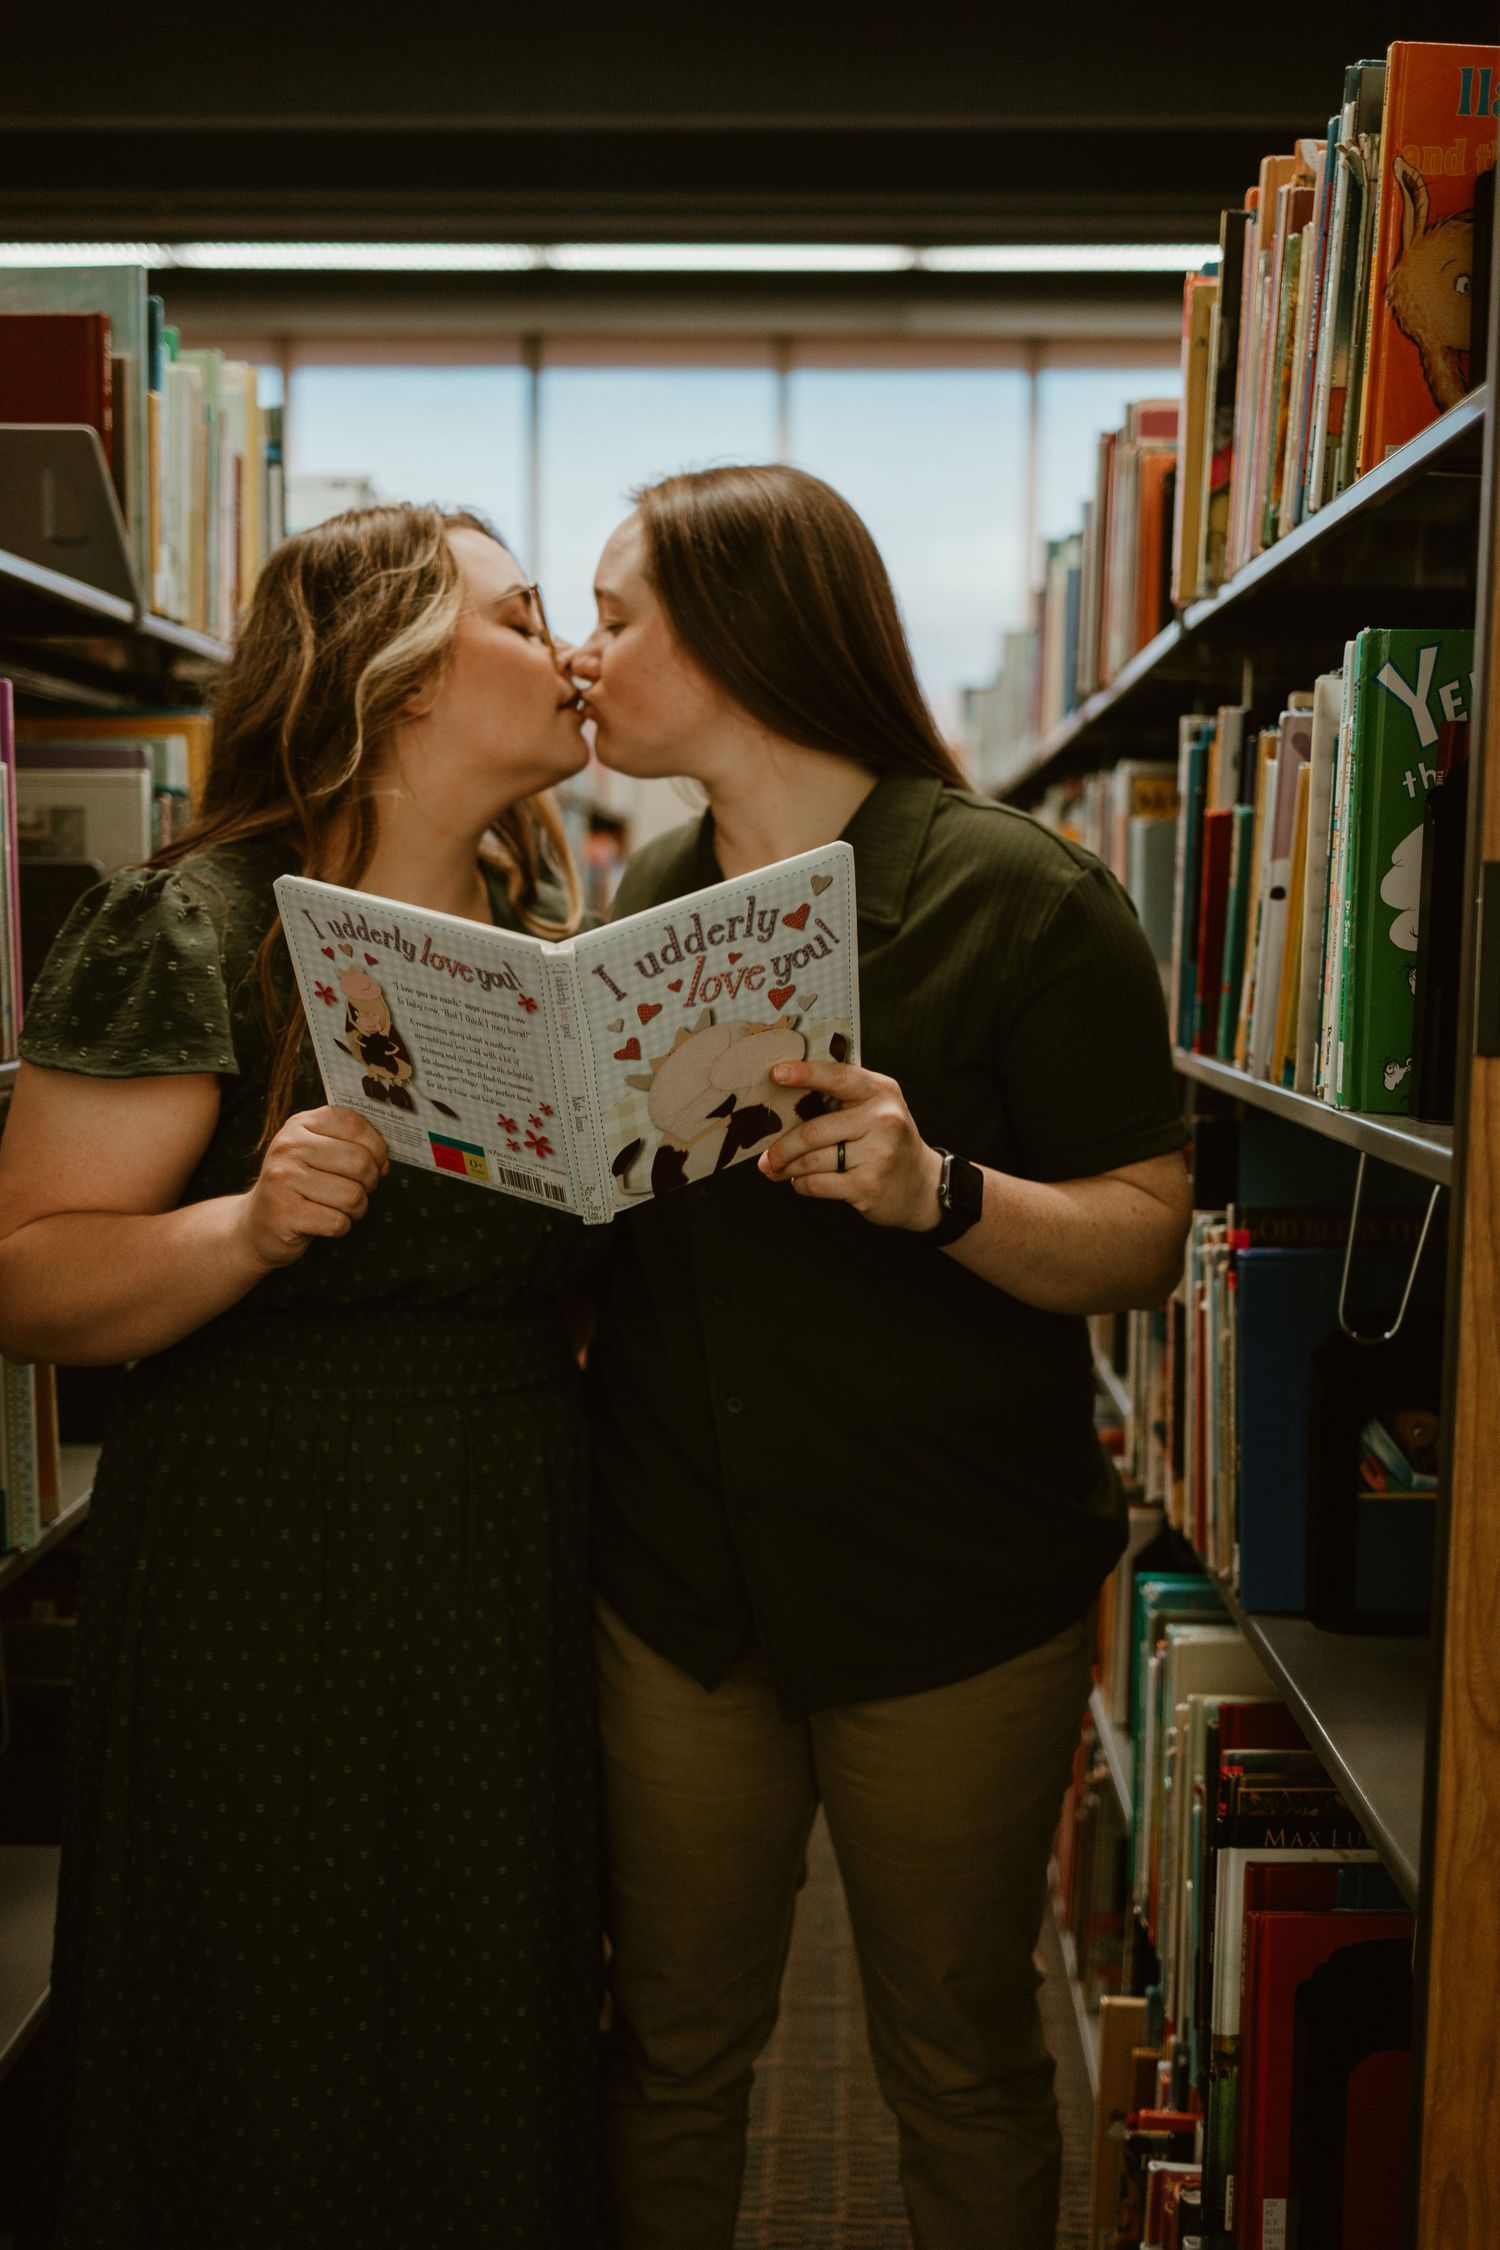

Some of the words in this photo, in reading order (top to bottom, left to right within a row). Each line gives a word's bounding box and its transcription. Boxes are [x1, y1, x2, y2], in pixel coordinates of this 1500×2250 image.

[302, 909, 324, 940] I
[327, 911, 416, 962] udderly
[418, 934, 474, 983] love
[475, 961, 523, 992] you!
[592, 964, 627, 1001] I
[634, 896, 780, 978] udderly
[683, 955, 765, 1008] love
[770, 918, 840, 986] you!
[400, 984, 414, 993] love
[416, 990, 428, 999] you
[512, 1016, 525, 1024] cow
[555, 976, 568, 1005] udderly
[397, 996, 404, 1004] to
[405, 998, 422, 1011] baby
[465, 1014, 484, 1027] think
[491, 1024, 506, 1034] may
[449, 1029, 465, 1040] story
[465, 1033, 483, 1044] about
[445, 1052, 456, 1060] and
[491, 1065, 506, 1074] with
[482, 1051, 497, 1060] with
[496, 1076, 507, 1086] the
[1265, 1828, 1320, 1847] MAX
[1331, 1828, 1363, 1847] LU
